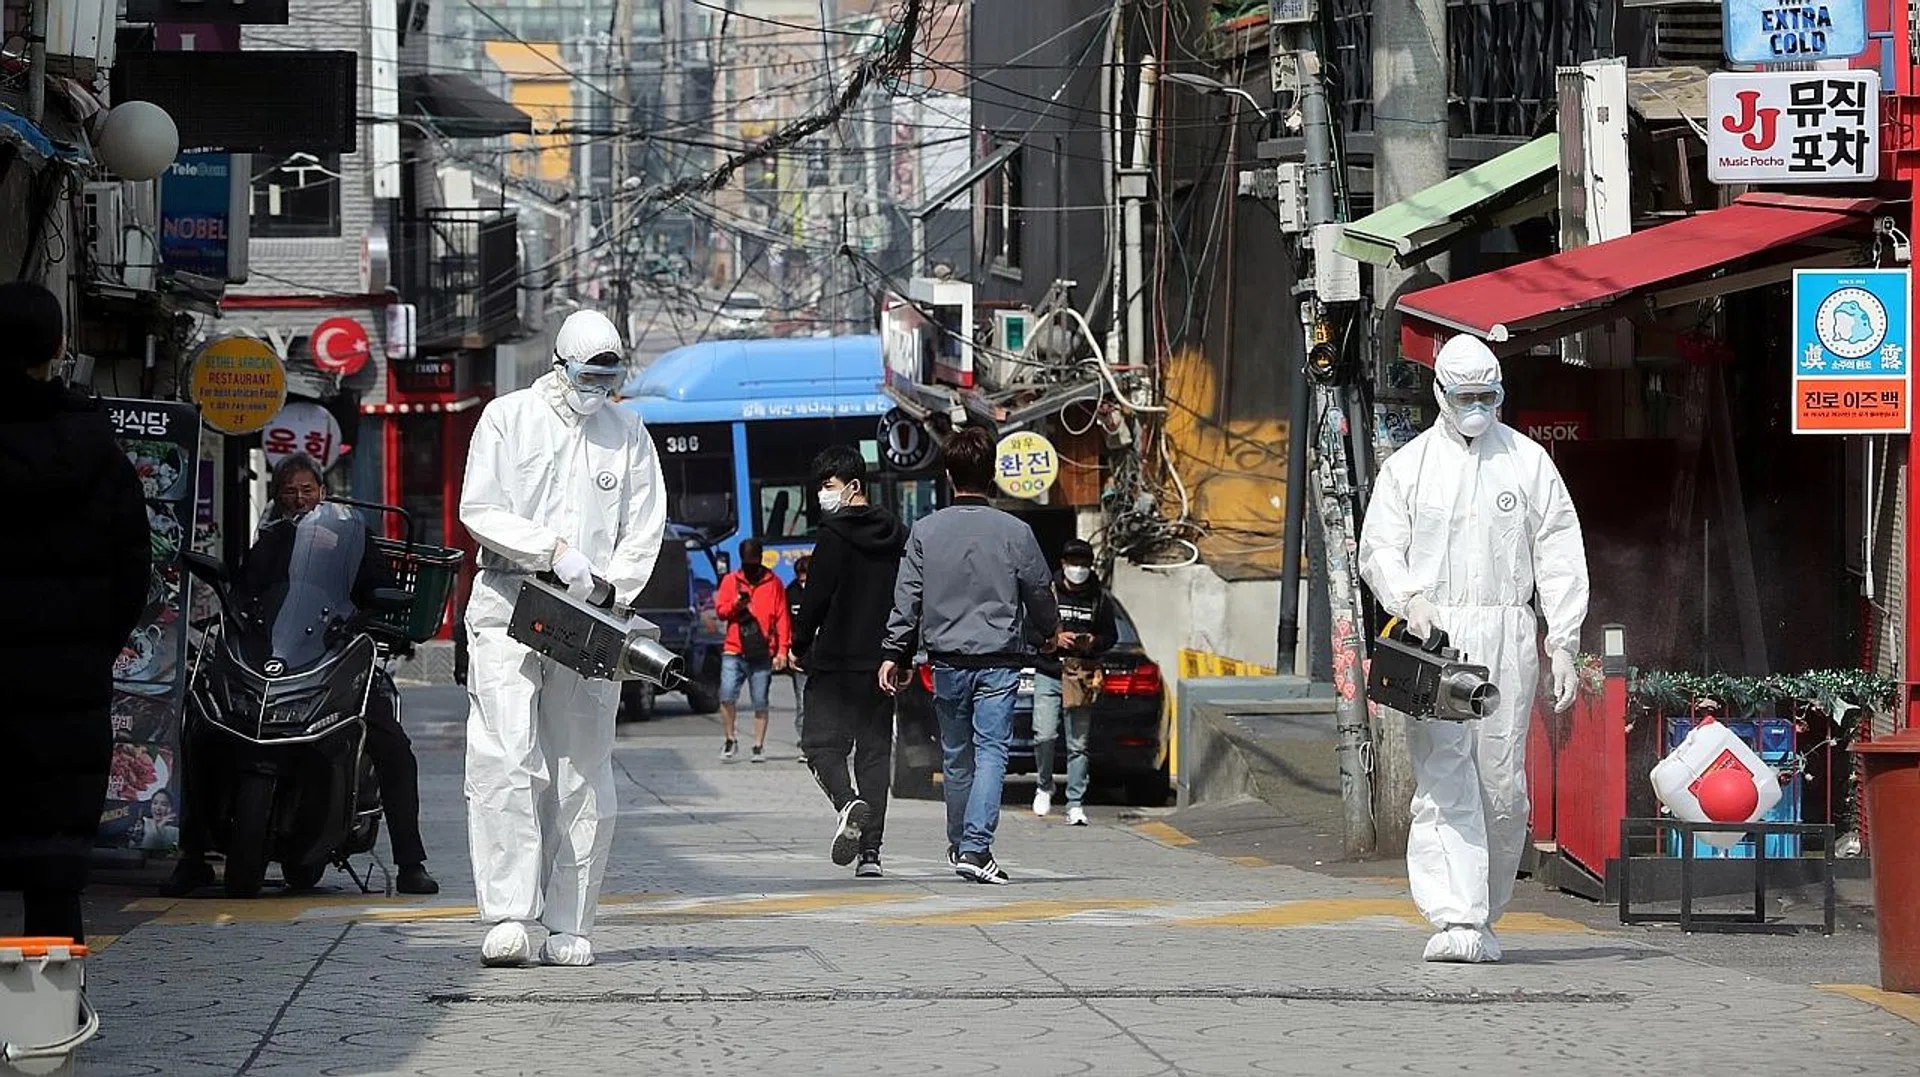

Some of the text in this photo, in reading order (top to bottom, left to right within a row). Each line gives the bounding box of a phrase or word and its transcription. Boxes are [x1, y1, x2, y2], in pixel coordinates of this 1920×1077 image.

[1762, 6, 1832, 31] EXTRA
[1770, 31, 1826, 54] COLD
[1787, 79, 1867, 128] 뮤직
[1722, 91, 1781, 150] JJ
[1788, 126, 1870, 174] 포차
[1719, 157, 1785, 167] Music Pocha
[163, 216, 228, 240] NOBEL
[208, 372, 271, 385] RESTAURANT
[1805, 391, 1899, 409] 진로 이즈 백
[666, 435, 699, 453] 386
[1528, 425, 1579, 441] NSOK
[1000, 450, 1051, 477] 환전
